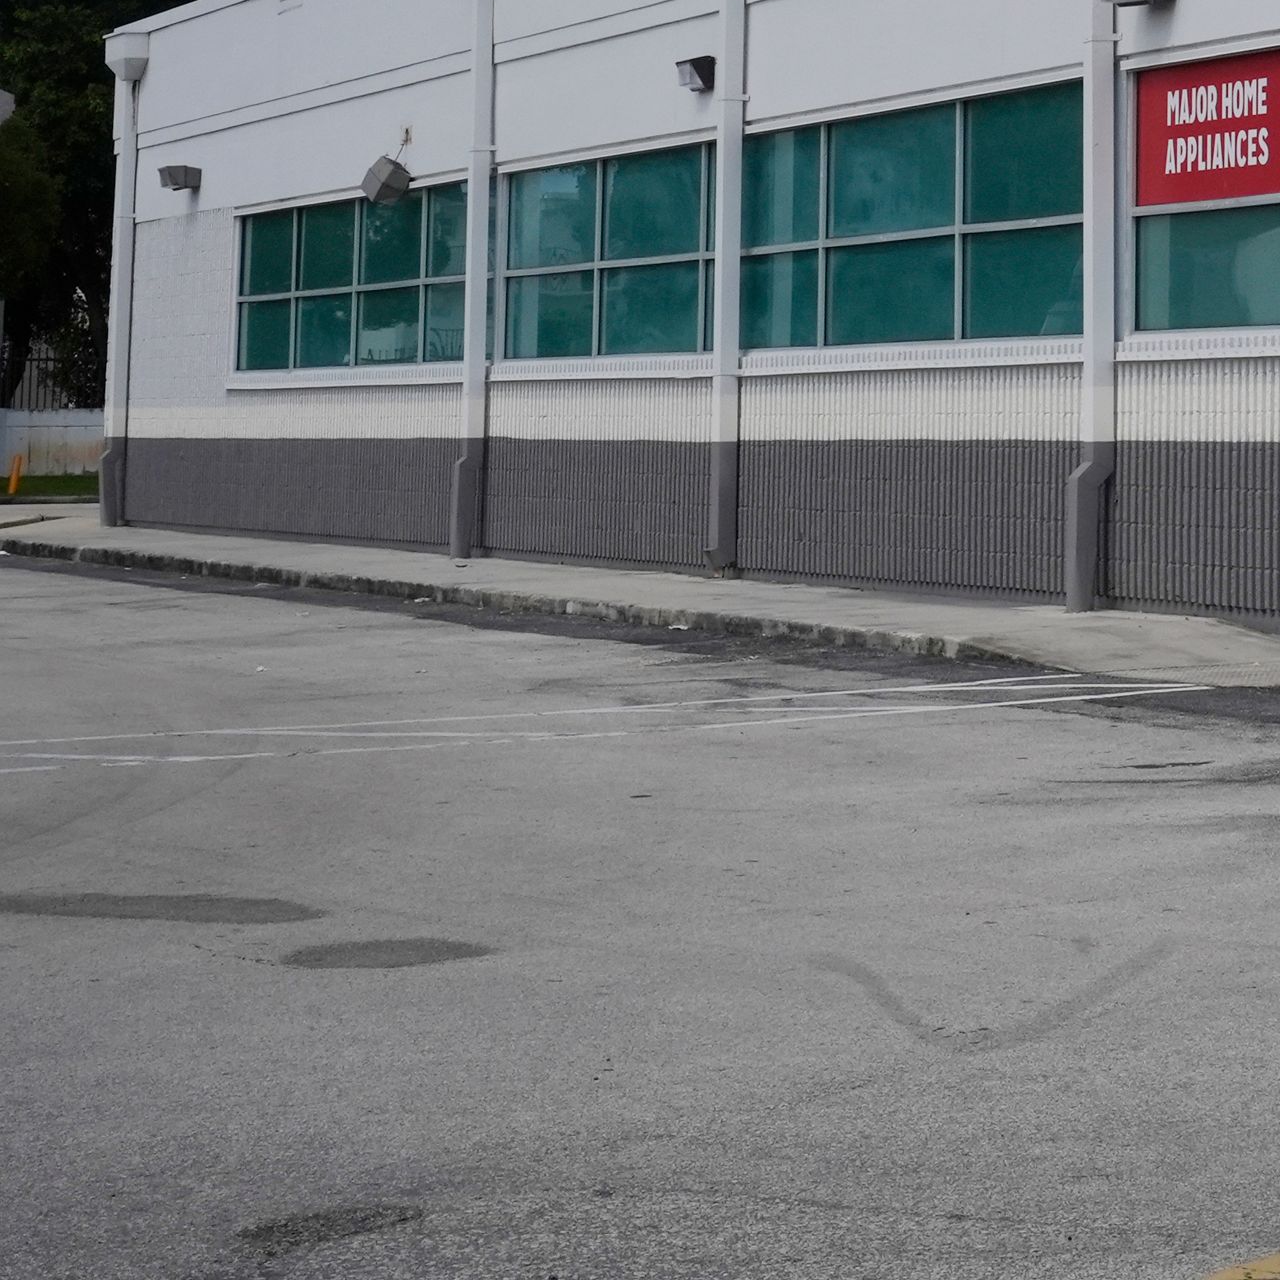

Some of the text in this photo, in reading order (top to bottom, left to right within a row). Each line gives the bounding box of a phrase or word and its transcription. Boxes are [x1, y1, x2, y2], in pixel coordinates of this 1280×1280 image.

[1167, 77, 1269, 127] MAJOR HOME
[1165, 127, 1270, 175] APPLIANCES
